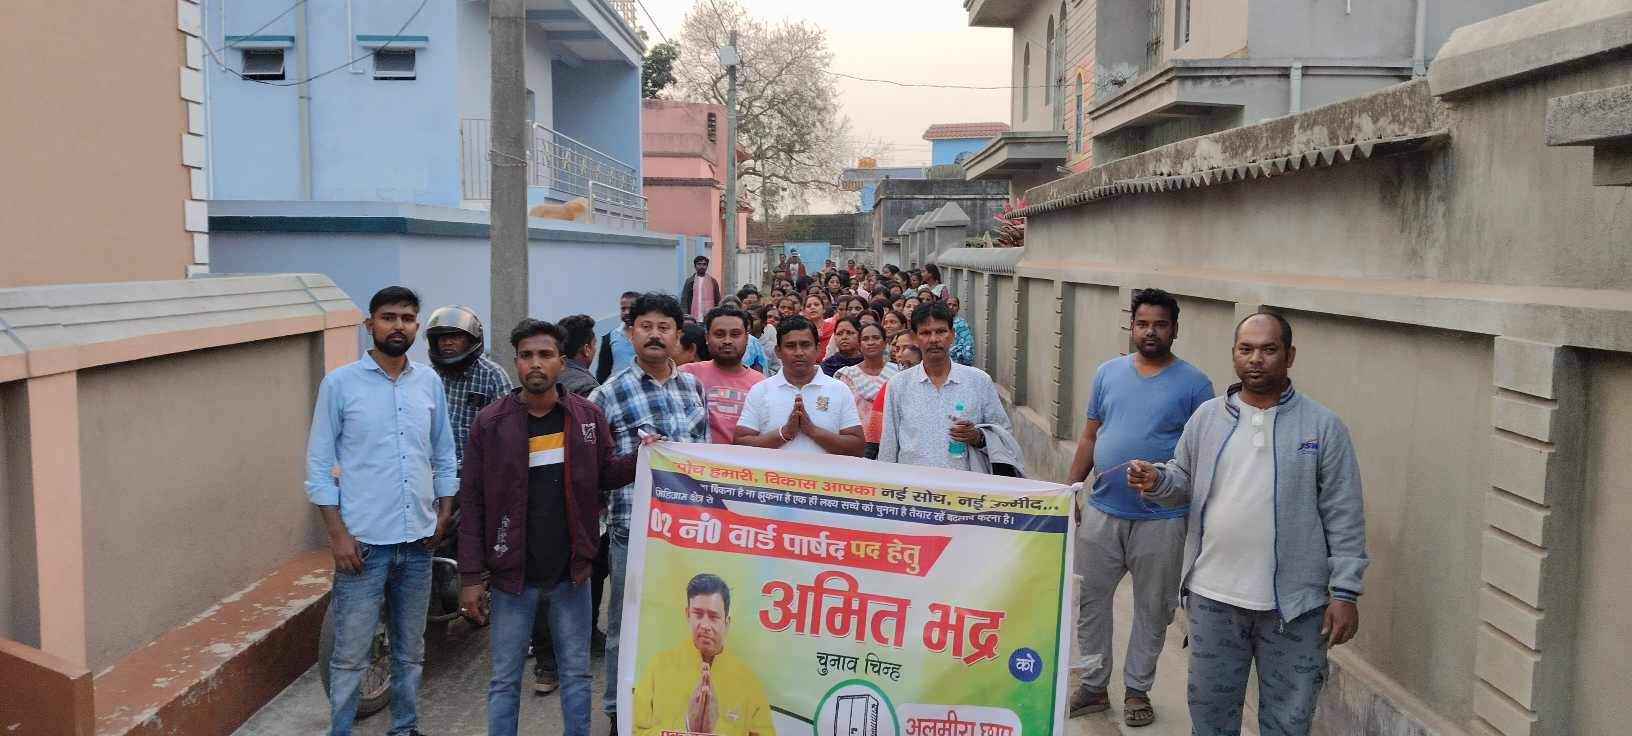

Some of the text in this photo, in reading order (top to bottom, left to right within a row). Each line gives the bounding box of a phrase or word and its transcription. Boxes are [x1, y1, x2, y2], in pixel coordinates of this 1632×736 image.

[706, 494, 715, 504] से
[710, 465, 757, 483] हमारी,
[766, 472, 817, 489] विकास
[822, 481, 877, 496] आपका
[881, 486, 908, 502] नई
[958, 494, 987, 511] नई
[745, 489, 756, 500] ना
[757, 491, 783, 503] झुकना
[792, 494, 807, 505] एक
[808, 495, 818, 506] ही
[861, 502, 875, 513] को
[876, 505, 900, 517] चुनना
[900, 505, 908, 518] है
[909, 507, 933, 520] तैयार
[977, 513, 1002, 523] करना
[728, 523, 777, 550] वार्ड
[782, 530, 848, 560] पार्षद
[850, 540, 882, 559] पद
[886, 539, 922, 574] हेतु
[759, 571, 1005, 666] अमित भद्र
[816, 652, 903, 682] चुनाव चिन्ह
[1015, 653, 1035, 673] को
